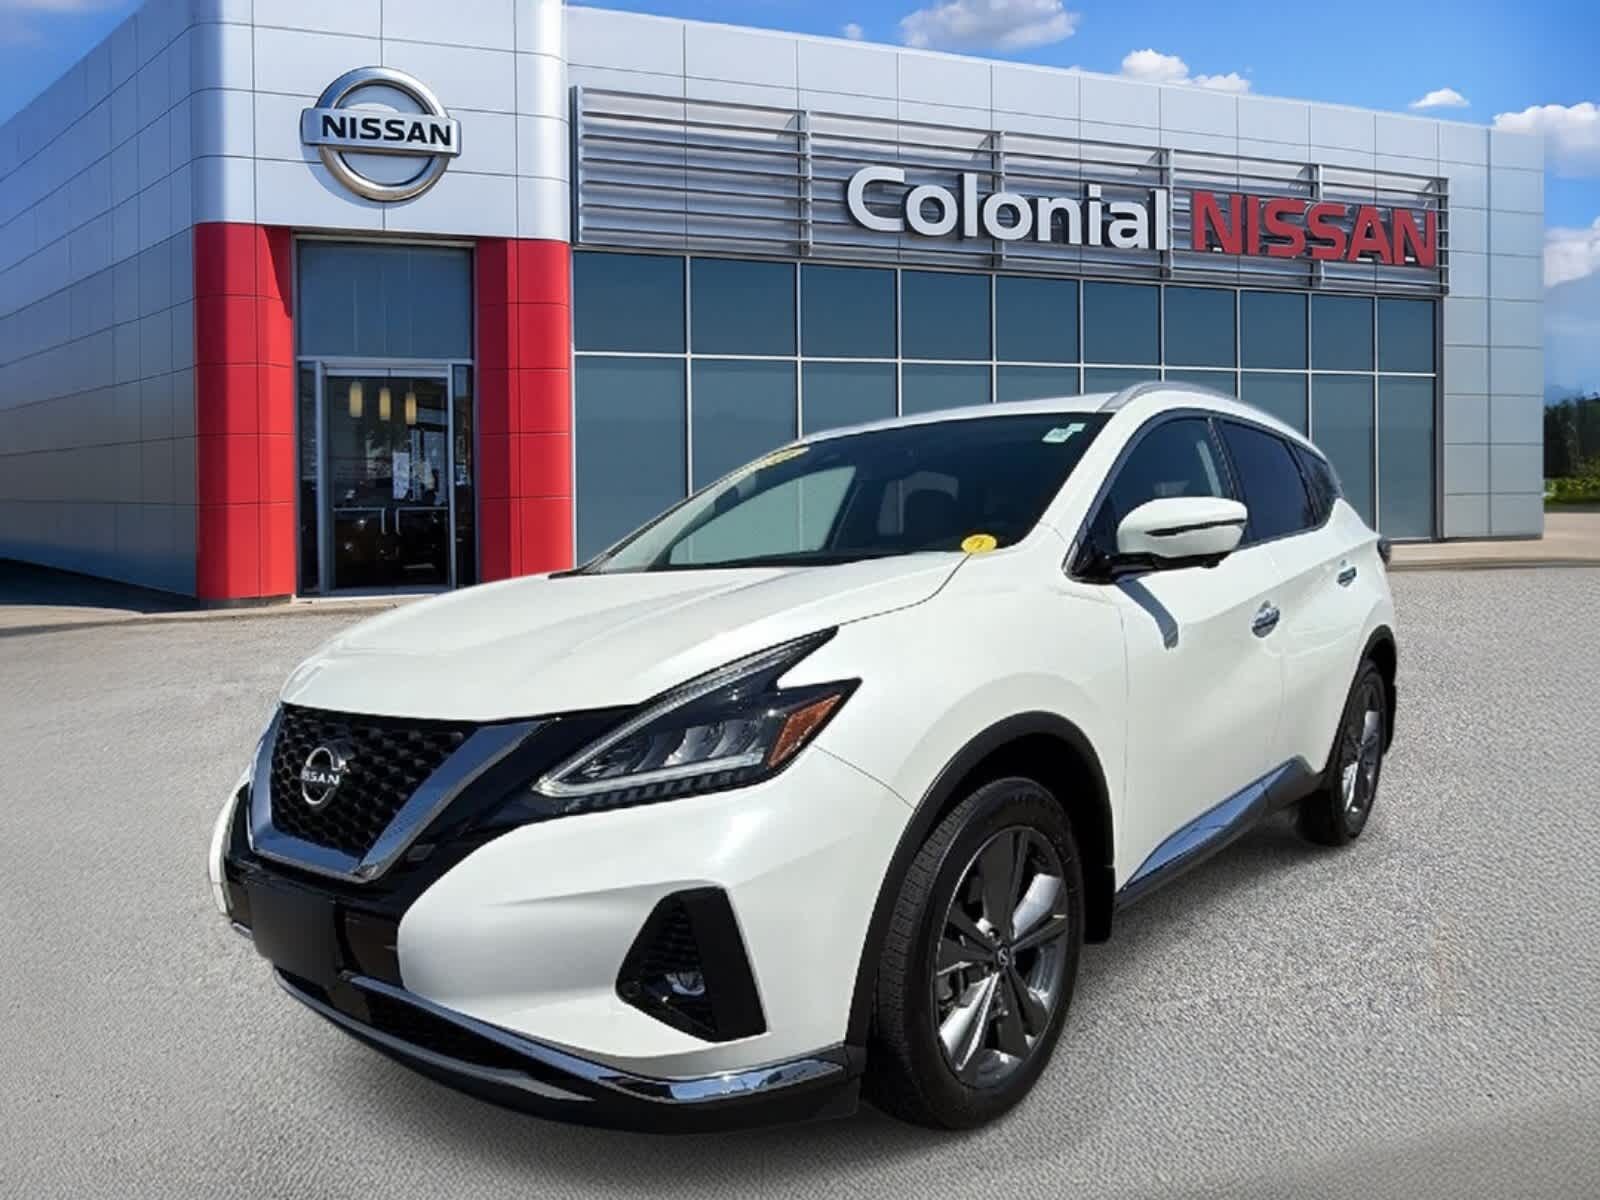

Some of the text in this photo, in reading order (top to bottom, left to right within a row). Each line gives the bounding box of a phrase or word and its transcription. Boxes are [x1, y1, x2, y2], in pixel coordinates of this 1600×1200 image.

[322, 115, 451, 146] NISSAN
[846, 165, 1437, 267] Colonial NISSAN
